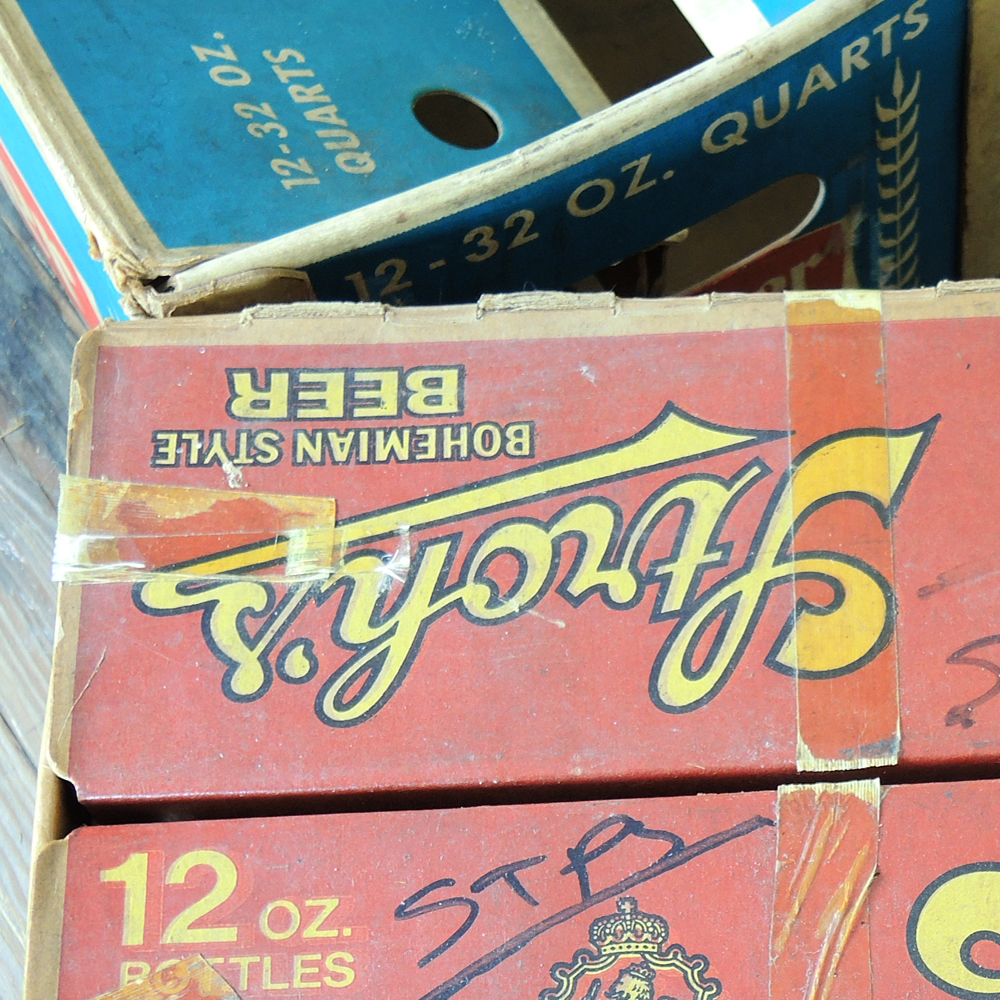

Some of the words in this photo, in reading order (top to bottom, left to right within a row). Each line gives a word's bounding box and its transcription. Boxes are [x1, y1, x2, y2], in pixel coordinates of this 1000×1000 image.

[190, 31, 252, 87] OZ.
[261, 48, 377, 178] QUARTS
[566, 152, 676, 218] OZ.
[700, 0, 929, 155] QUARTS
[225, 363, 466, 422] BEER
[150, 428, 285, 469] STYLE
[292, 419, 537, 467] BOHEMIAN
[132, 400, 942, 725] Stroh's
[99, 849, 239, 947] 12
[258, 898, 353, 941] OZ.
